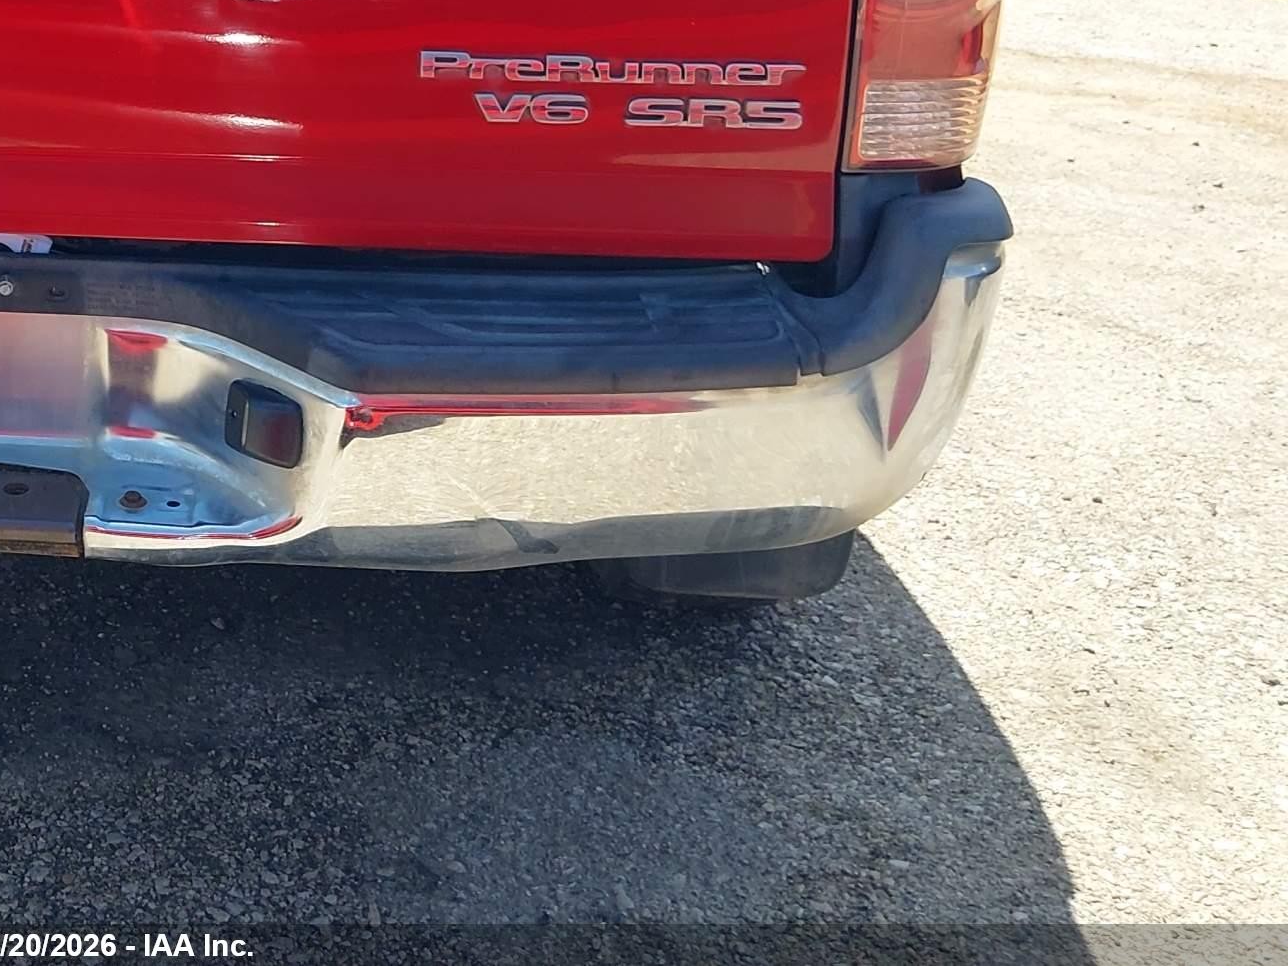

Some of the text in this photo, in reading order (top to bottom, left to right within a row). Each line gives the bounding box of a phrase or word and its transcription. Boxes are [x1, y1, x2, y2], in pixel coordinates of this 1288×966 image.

[419, 50, 806, 86] PreRunner
[473, 93, 803, 130] V6 SR5
